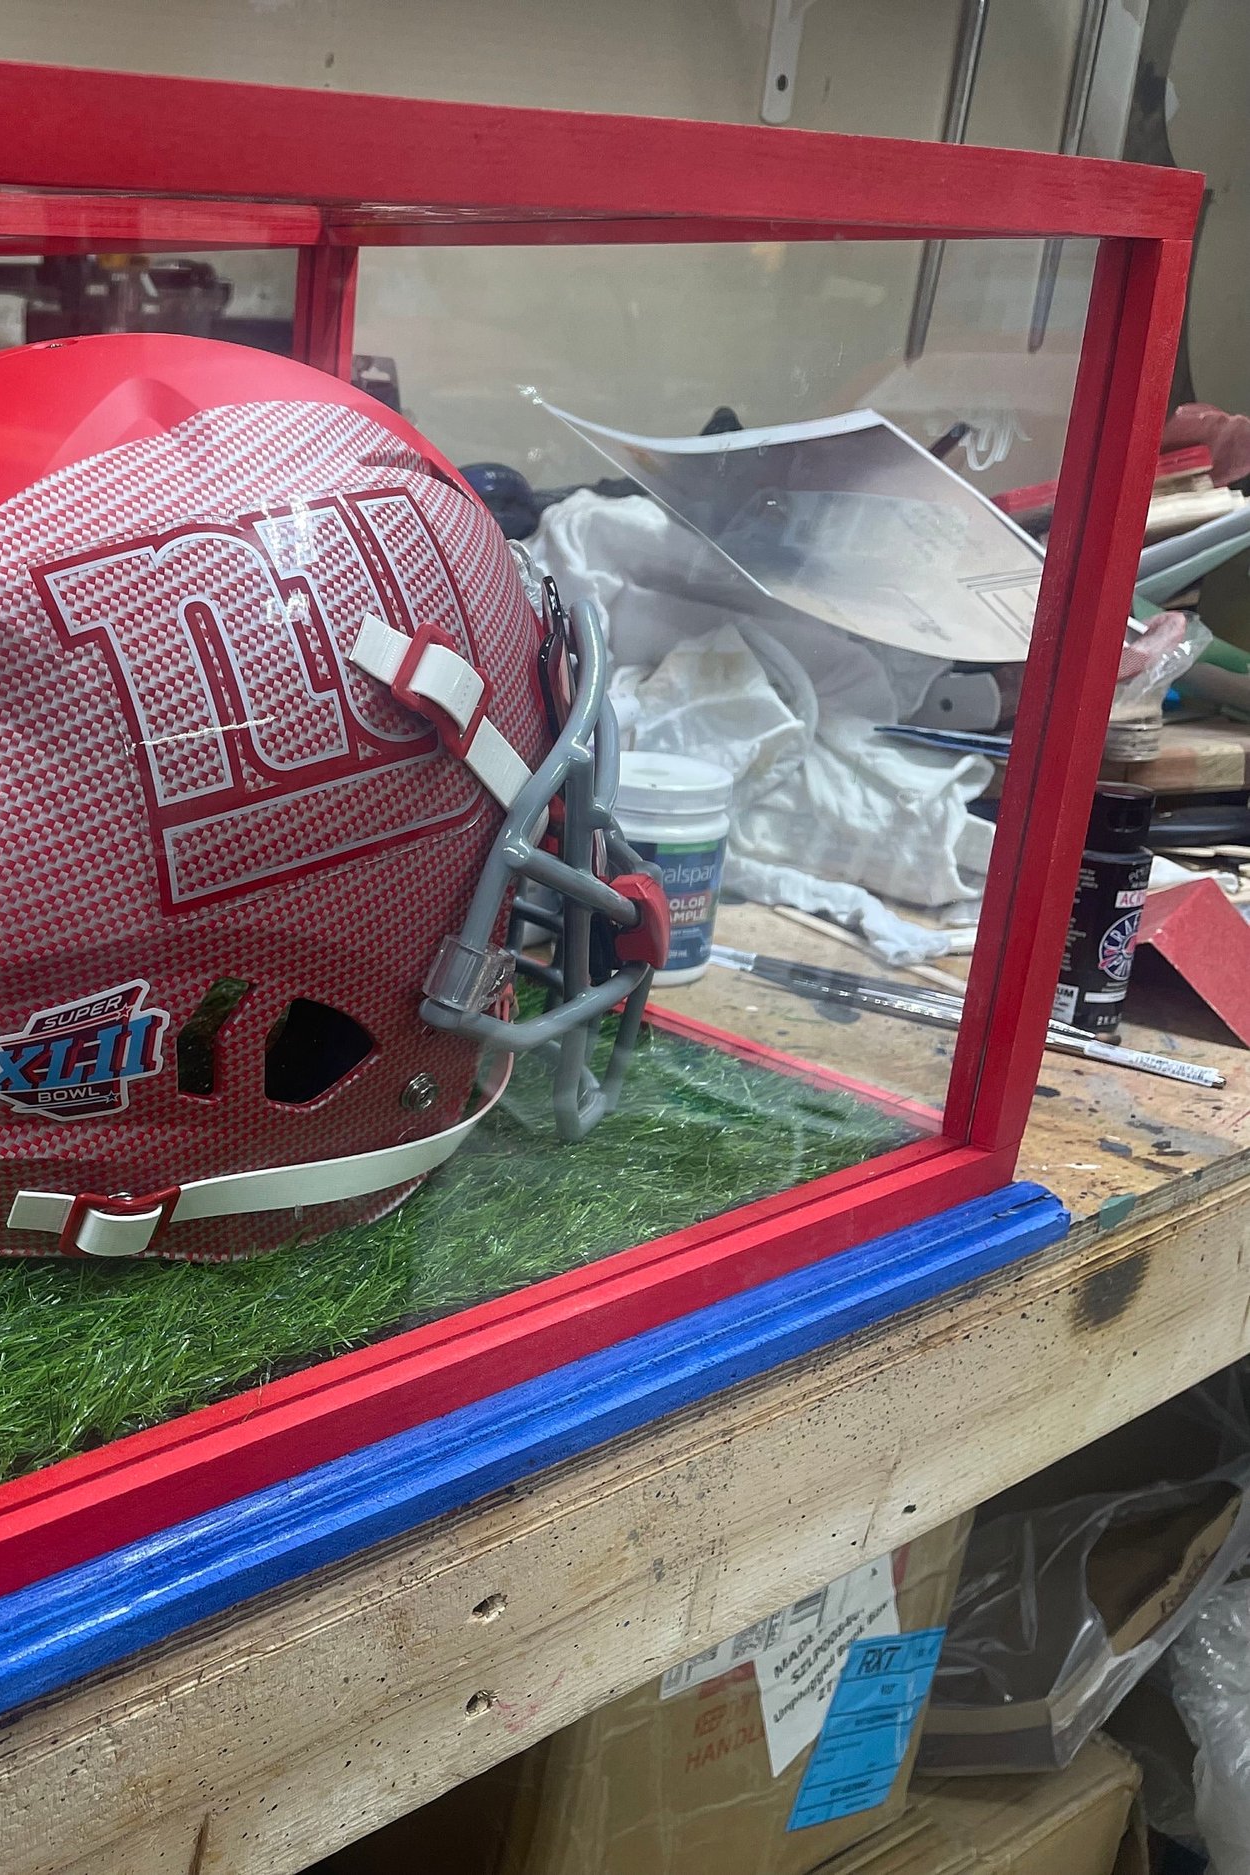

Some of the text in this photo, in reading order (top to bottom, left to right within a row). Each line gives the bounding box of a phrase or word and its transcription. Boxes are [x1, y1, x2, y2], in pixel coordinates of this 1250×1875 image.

[669, 896, 706, 911] OLOR
[42, 995, 123, 1030] SUPER
[38, 1086, 100, 1103] BOWL
